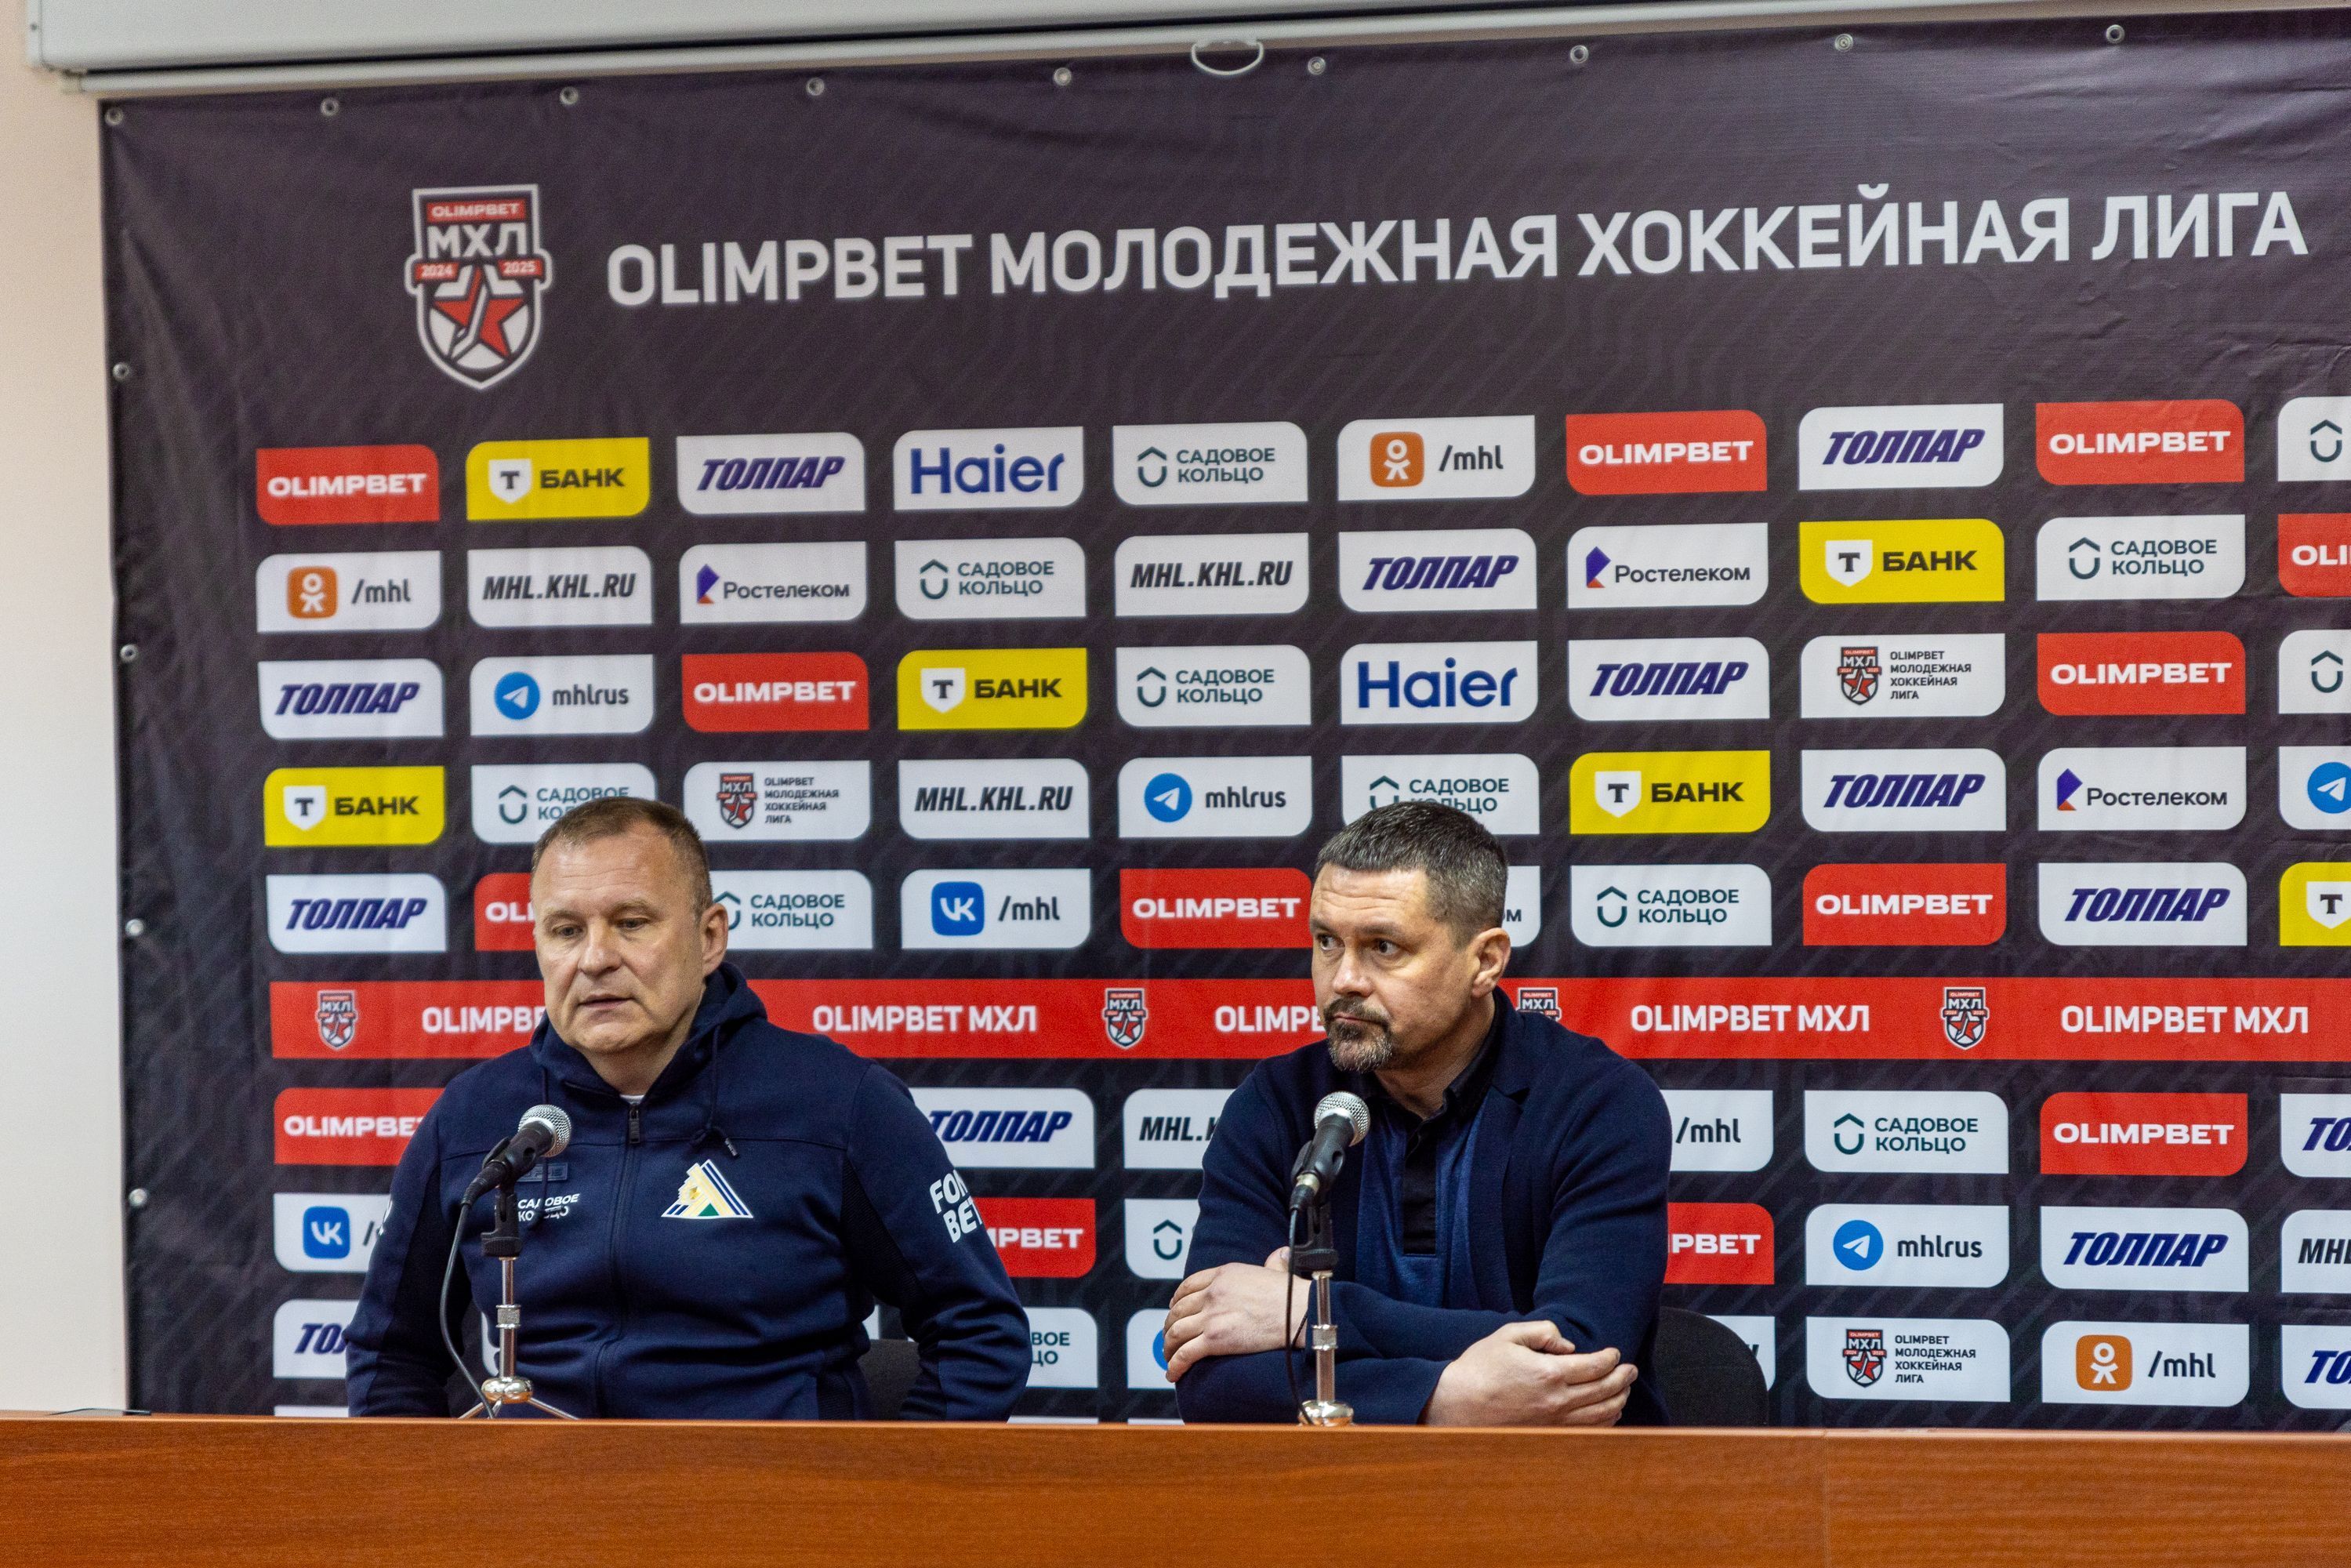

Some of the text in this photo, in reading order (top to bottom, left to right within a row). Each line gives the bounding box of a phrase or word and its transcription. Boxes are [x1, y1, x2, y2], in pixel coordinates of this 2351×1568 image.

[432, 202, 521, 217] OLIMPBET
[426, 222, 527, 259] МХЛ
[607, 183, 2309, 307] OLIMPBET МОЛОДЕЖНАЯ ХОККЕЙНАЯ ЛИГА
[1579, 440, 1754, 466] OLIMPBET
[1822, 428, 1986, 466] ТОЛПАР
[2048, 430, 2231, 455] OLIMPBET
[1176, 447, 1275, 466] САДОВОЕ
[1439, 445, 1504, 473] /mhl
[500, 467, 625, 490] Т БАНК
[697, 456, 846, 492] ТОЛПАР
[910, 443, 1065, 495] Haier
[1177, 466, 1264, 485] КОЛЬЦО
[267, 473, 427, 498] OLIMPBET
[2110, 539, 2218, 558] САДОВОЕ
[2291, 544, 2351, 566] OLI
[957, 561, 1054, 579] САДОВОЕ
[1838, 550, 1977, 573] Т БАНК
[2112, 558, 2205, 577] КОЛЬЦО
[1130, 561, 1293, 589] MHL.KHL.RU
[1362, 555, 1519, 591] ТОЛПАР
[1615, 564, 1751, 583] Ростелеком
[351, 579, 412, 605] /mhl
[482, 573, 637, 601] MHL.KHL.RU
[723, 581, 851, 600] Ростелеком
[959, 579, 1043, 597] КОЛЬЦО
[1844, 657, 1876, 666] МХЛ
[1889, 650, 1945, 661] OLIMPBET
[1175, 668, 1275, 687] САДОВОЕ
[1589, 661, 1749, 697] ТОЛПАР
[1890, 663, 1972, 676] МОЛОДЕЖНАЯ
[2050, 662, 2233, 685] OLIMPBET
[693, 681, 857, 704] OLIMPBET
[932, 678, 1062, 699] Т БАНК
[1358, 657, 1518, 709] Haier
[1890, 677, 1958, 687] ХОККЕЙНАЯ
[275, 682, 421, 716] ТОЛПАР
[552, 684, 629, 706] mhlrus
[1177, 688, 1263, 706] КОЛЬЦО
[1890, 690, 1920, 700] ЛИГА
[723, 783, 751, 792] МХЛ
[764, 776, 815, 786] OLIMPBET
[1409, 777, 1510, 796] САДОВОЕ
[1823, 773, 1986, 808] ТОЛПАР
[764, 789, 840, 800] МОЛОДЕЖНАЯ
[914, 786, 1073, 812] MHL.KHL.RU
[1205, 786, 1286, 808] mhlrus
[1607, 782, 1744, 804] Т БАНК
[2087, 787, 2228, 807] Ростелеком
[294, 796, 419, 817] Т БАНК
[765, 800, 827, 811] ХОККЕЙНАЯ
[1410, 797, 1497, 814] ЛЬЦО
[765, 815, 792, 824] ЛИГА
[750, 894, 845, 911] САДОВОЕ
[998, 895, 1061, 922] /mhl
[1132, 897, 1301, 920] OLIMPBET
[1637, 888, 1740, 907] САДОВОЕ
[1815, 894, 1994, 916] OLIMPBET
[2064, 887, 2230, 922] ТОЛПАР
[286, 898, 428, 931] ТОЛПАР
[751, 912, 835, 930] КОЛЬЦО
[1638, 908, 1728, 926] КОЛЬЦО
[1109, 1000, 1141, 1010] МХЛ
[1522, 999, 1554, 1009] МХЛ
[1948, 999, 1982, 1009] МХЛ
[812, 1005, 1037, 1033] OLIMPBET МХЛ
[1630, 1004, 1870, 1033] OLIMPBET МХЛ
[2061, 1005, 2309, 1034] OLIMPBET МХЛ
[928, 1109, 1072, 1142] ТОЛПАР
[1675, 1116, 1741, 1144] /mhl
[1874, 1117, 1979, 1135] САДОВОЕ
[2053, 1122, 2235, 1145] OLIMPBET
[2302, 1116, 2351, 1152] ТО
[1876, 1136, 1966, 1155] КОЛЬЦО
[1897, 1234, 1983, 1258] mhlrus
[2063, 1232, 2229, 1268] ТОЛПАР
[1849, 1339, 1881, 1348] МХЛ
[1894, 1334, 1950, 1345] OLIMPBET
[1894, 1359, 1963, 1371] ХОККЕЙНАЯ
[1895, 1348, 1976, 1360] МОЛОДЕЖНАЯ
[2147, 1350, 2216, 1378] /mhl
[1895, 1374, 1925, 1383] ЛИГА
[2304, 1350, 2351, 1385] ТО
